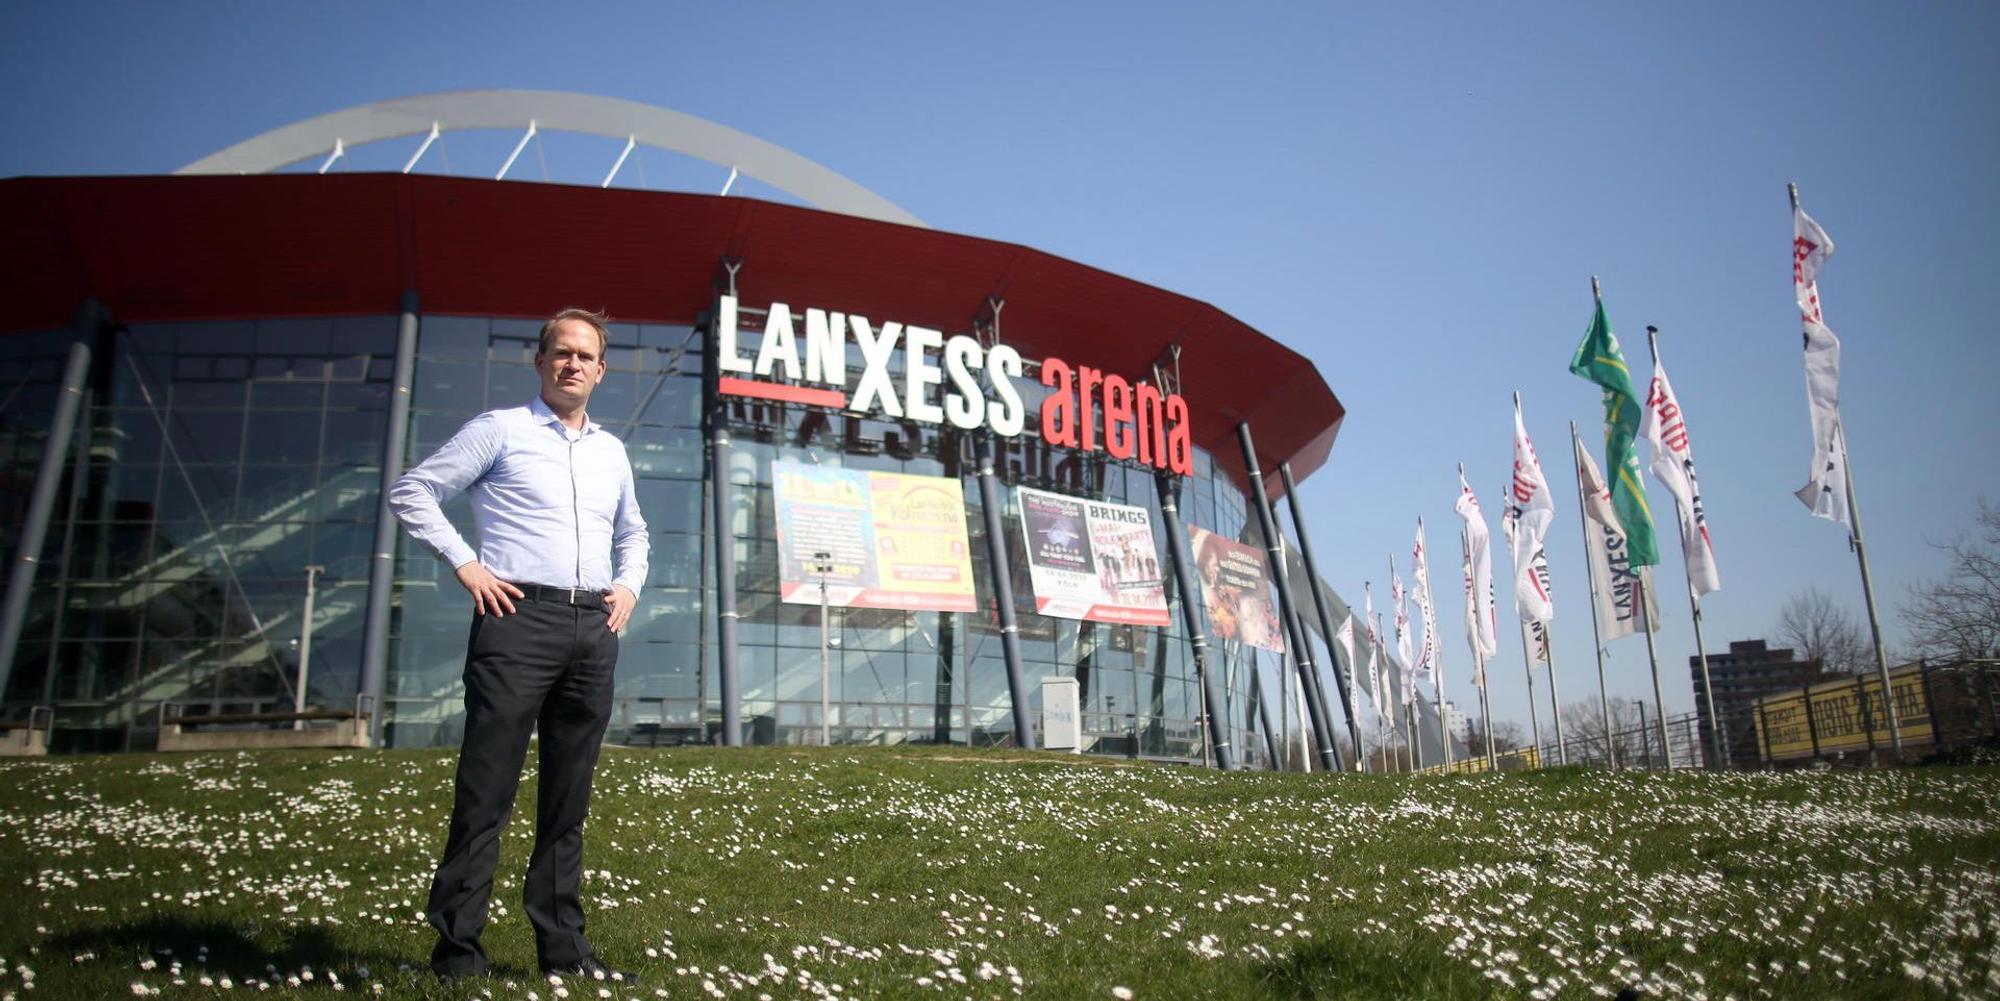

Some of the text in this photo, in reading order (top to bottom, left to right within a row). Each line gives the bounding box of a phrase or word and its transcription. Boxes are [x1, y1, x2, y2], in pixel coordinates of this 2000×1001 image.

[719, 295, 1194, 477] LANXESS arena
[1089, 505, 1147, 525] BRINGS
